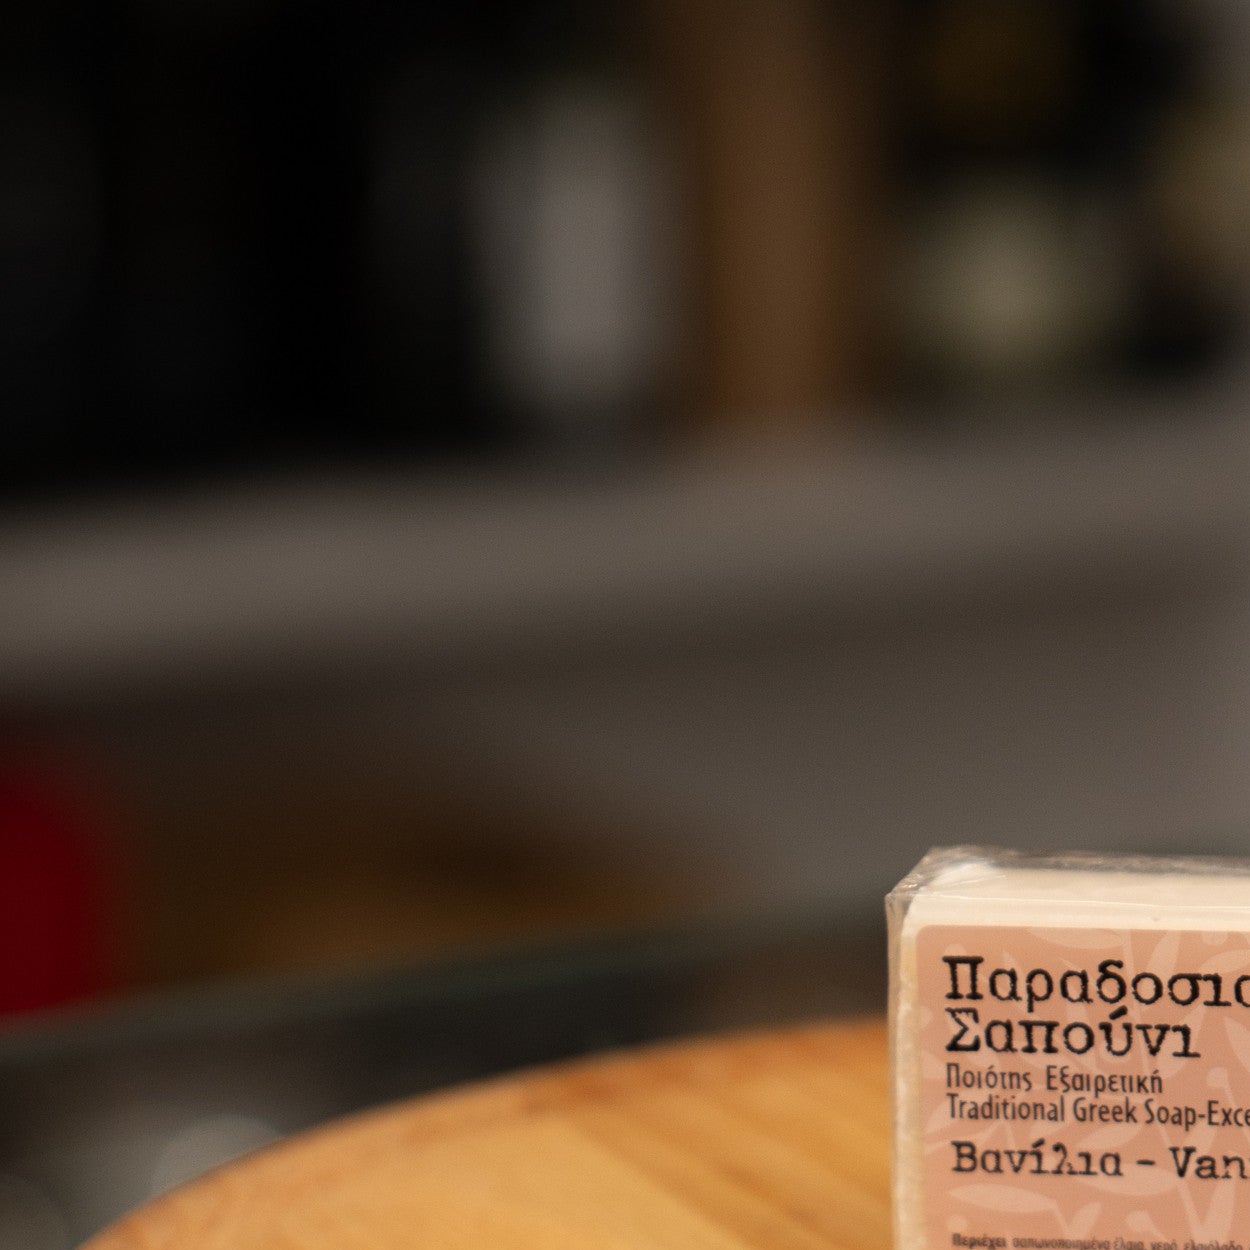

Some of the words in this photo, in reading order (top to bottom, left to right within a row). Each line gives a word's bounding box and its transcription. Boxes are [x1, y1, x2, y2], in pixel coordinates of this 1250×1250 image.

[945, 1005, 1201, 1058] Σαπούνι
[946, 1062, 1032, 1092] Ποιότης
[1046, 1065, 1163, 1098] Εξαιρετική
[946, 1093, 1065, 1122] Traditional
[1073, 1097, 1138, 1124] Greek
[951, 1138, 1124, 1176] Βανίλια
